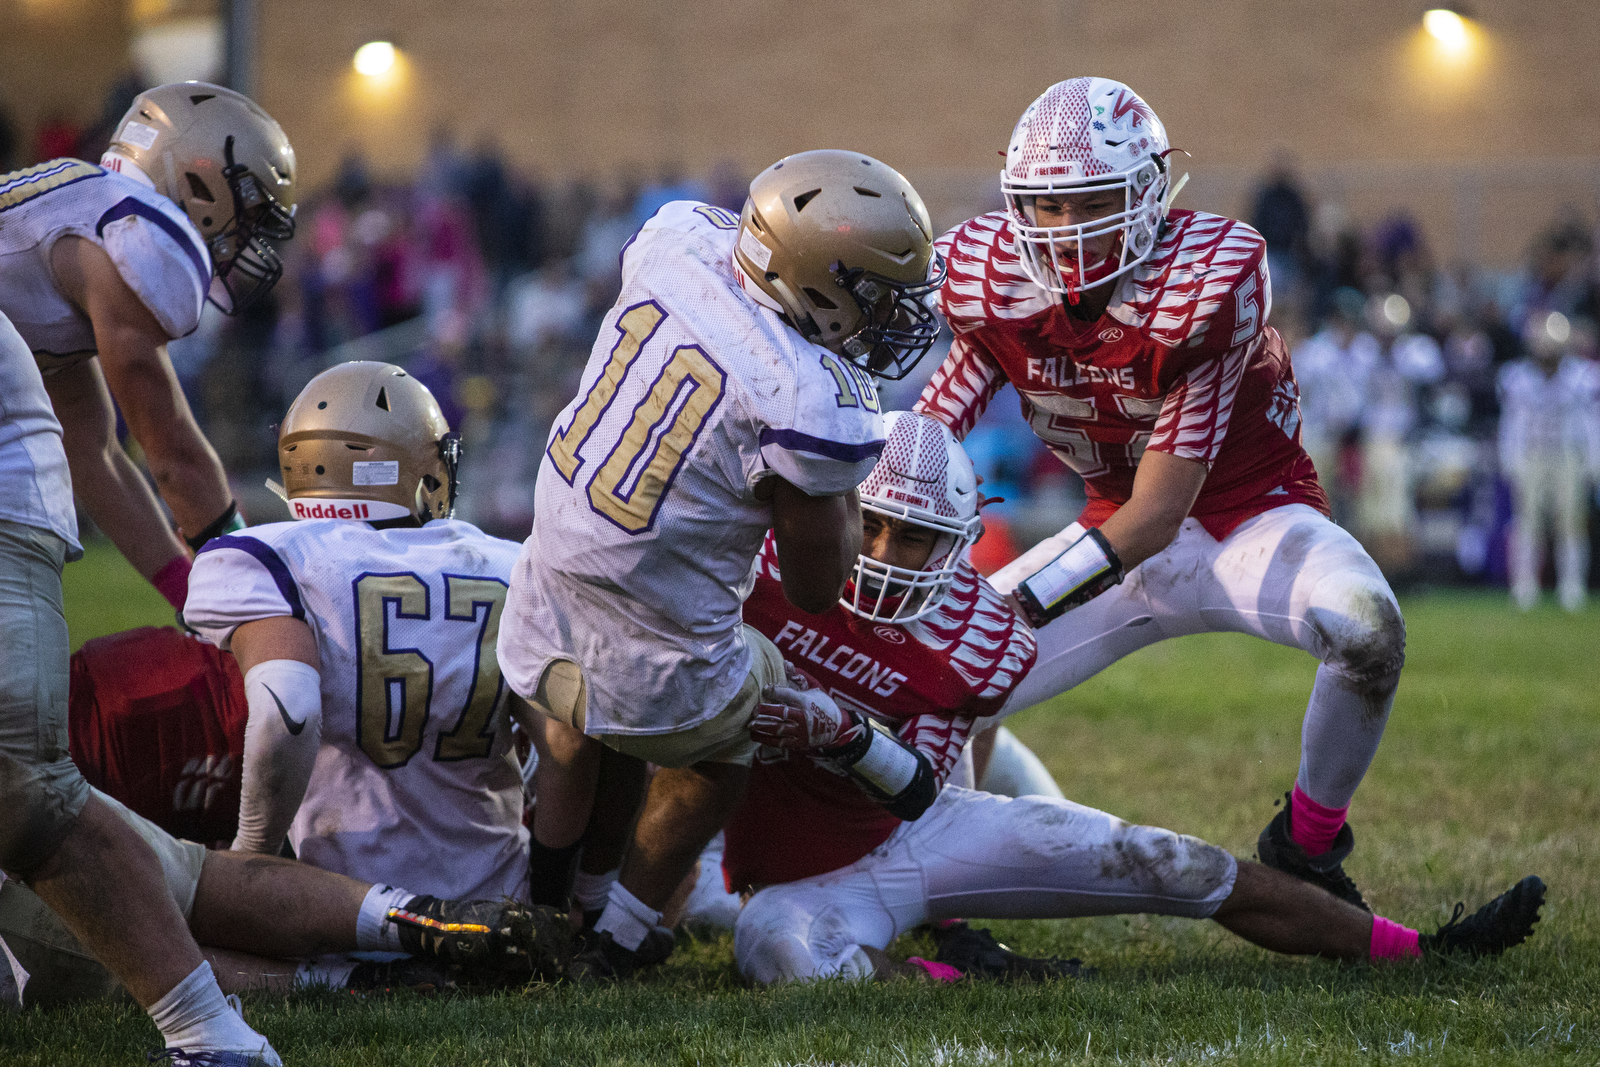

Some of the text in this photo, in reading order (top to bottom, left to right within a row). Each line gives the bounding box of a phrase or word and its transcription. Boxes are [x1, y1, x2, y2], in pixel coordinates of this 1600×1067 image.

[819, 354, 879, 414] 10
[1026, 356, 1136, 390] FALCONS
[547, 299, 727, 536] 10
[294, 502, 369, 520] Riddell
[894, 491, 907, 502] GET
[906, 494, 924, 507] SOME
[352, 571, 510, 770] 67
[773, 620, 908, 698] FALCONS
